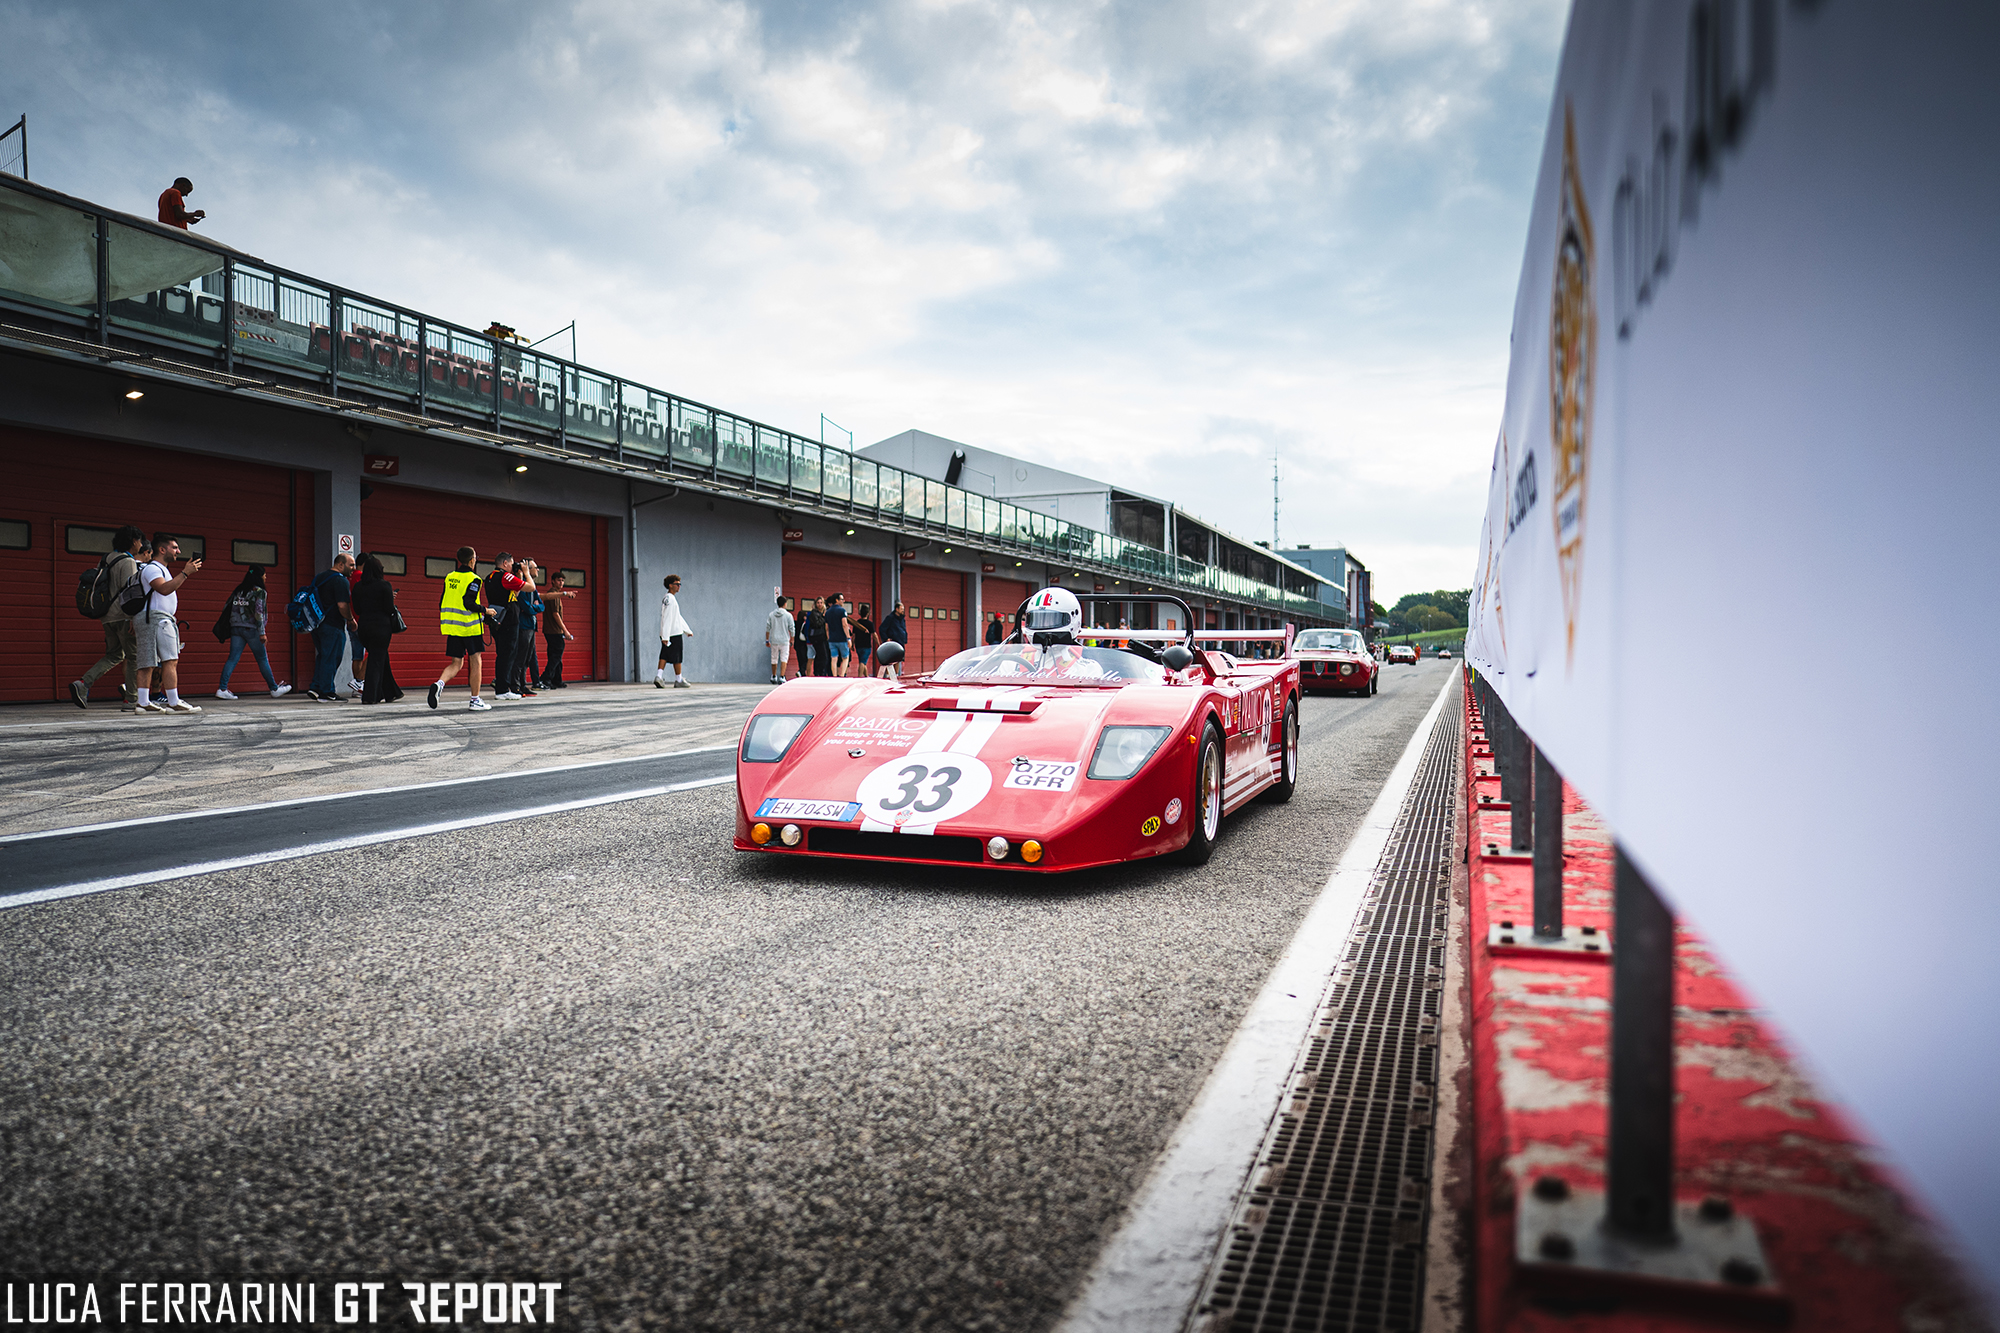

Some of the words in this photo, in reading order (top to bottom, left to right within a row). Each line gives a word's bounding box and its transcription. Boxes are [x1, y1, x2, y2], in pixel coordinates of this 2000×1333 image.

[371, 459, 395, 470] 21
[839, 716, 927, 732] PRATIKO
[834, 730, 870, 739] change
[872, 731, 891, 739] the
[877, 739, 913, 748] Wallet
[1015, 763, 1076, 777] Q770
[879, 764, 962, 812] 33
[1014, 775, 1064, 788] GFR
[1143, 818, 1159, 834] SPAX
